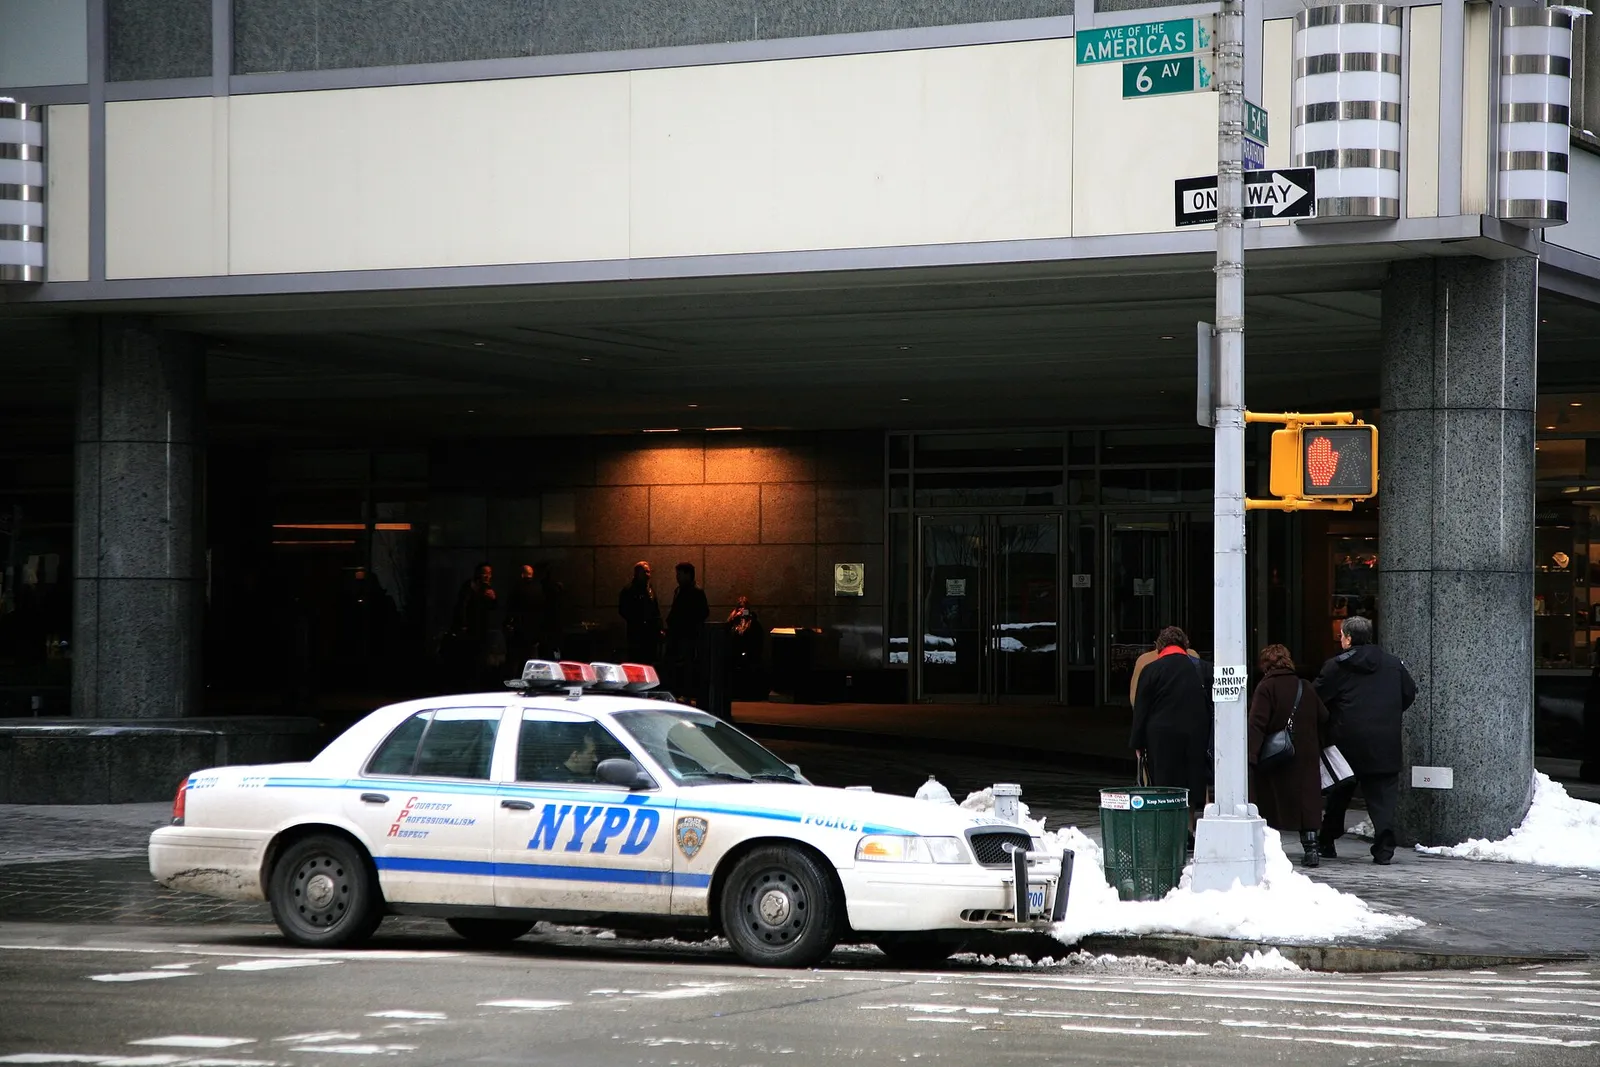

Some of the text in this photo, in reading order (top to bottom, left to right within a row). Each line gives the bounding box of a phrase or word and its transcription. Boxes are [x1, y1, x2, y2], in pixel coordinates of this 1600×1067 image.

[1103, 23, 1165, 40] AVE OF THE
[1083, 32, 1187, 62] AMERICAS
[1136, 62, 1180, 92] 6 AV
[1251, 107, 1261, 137] 54
[1193, 184, 1292, 210] ON WAY
[1222, 667, 1235, 675] NO
[527, 803, 660, 855] NYPD
[804, 812, 858, 832] POLICE
[1028, 892, 1043, 907] 700
